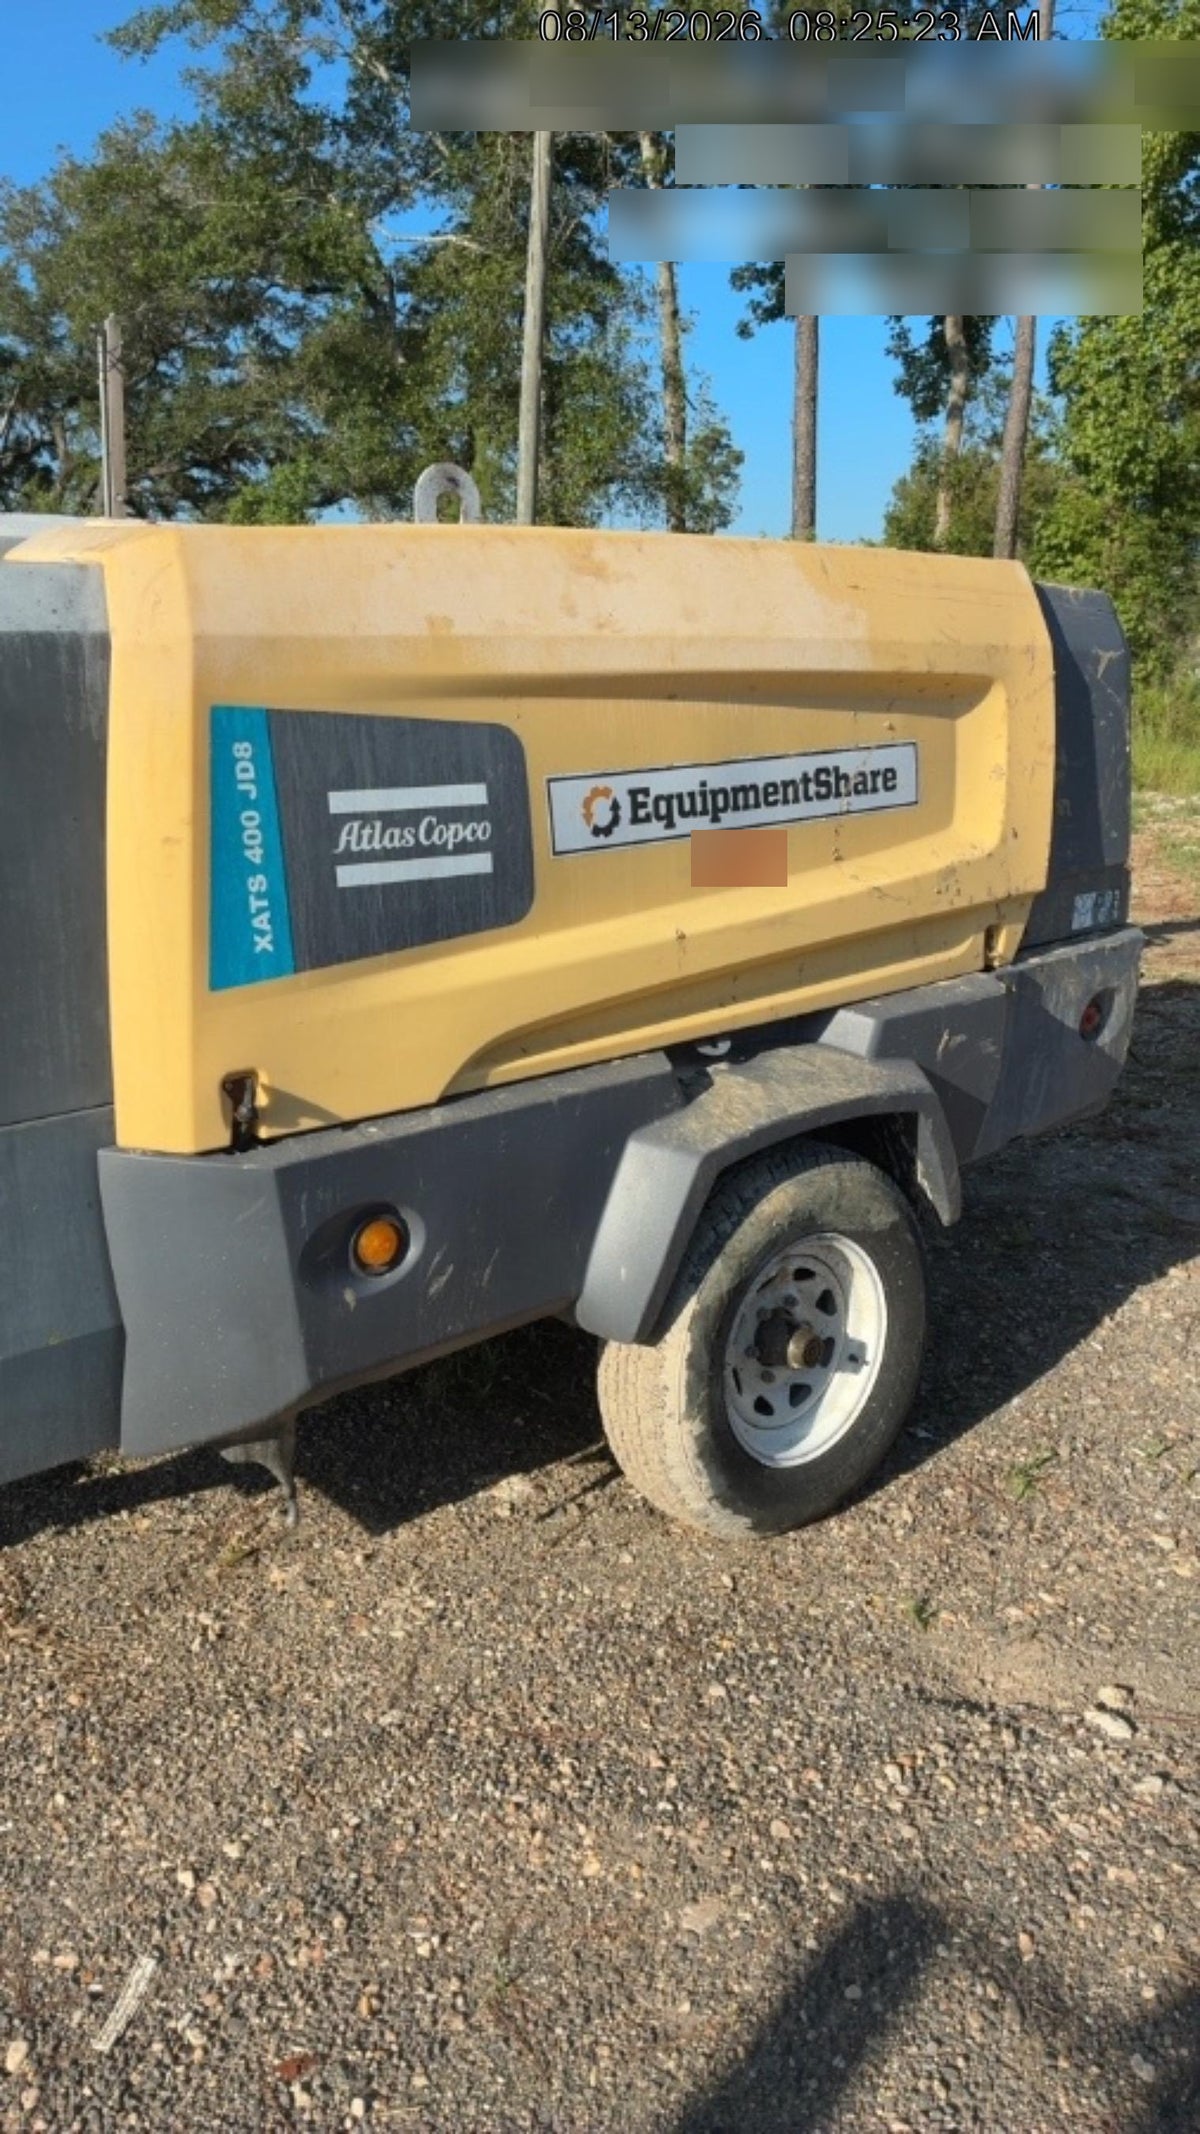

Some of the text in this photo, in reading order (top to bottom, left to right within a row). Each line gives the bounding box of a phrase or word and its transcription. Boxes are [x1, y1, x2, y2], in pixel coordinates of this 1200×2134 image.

[627, 766, 897, 829] EquipmentShare
[232, 741, 274, 953] XATS 400 JD8
[333, 815, 492, 854] Atlas Copco
